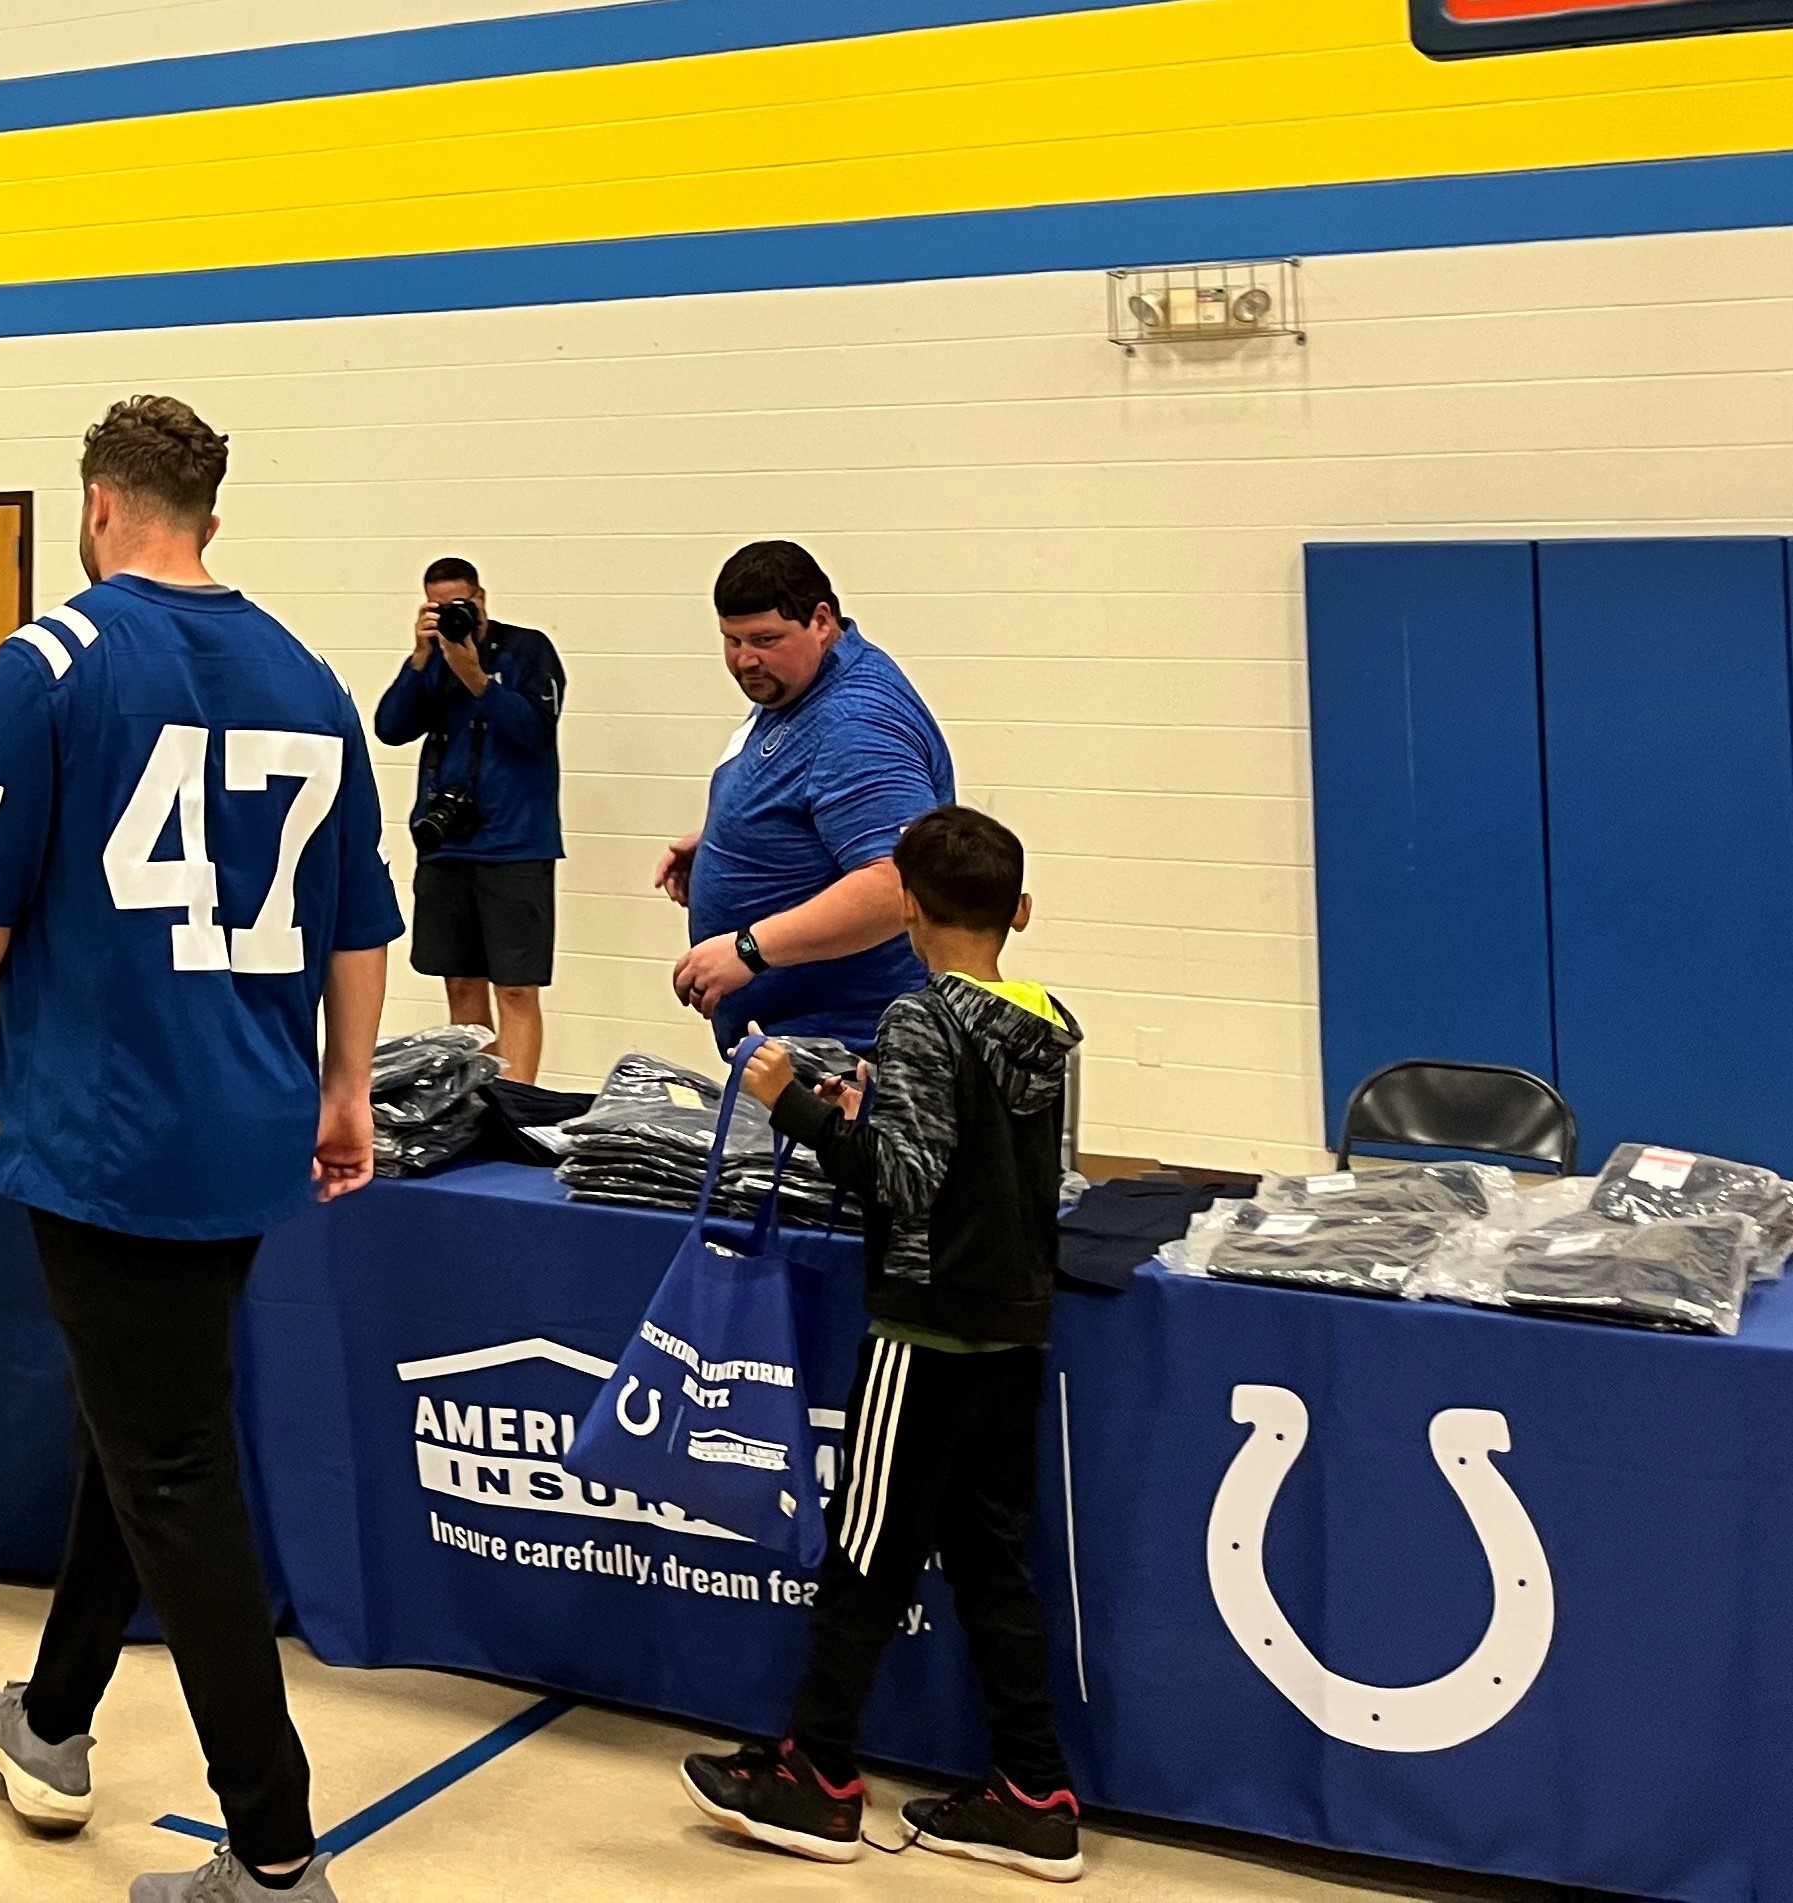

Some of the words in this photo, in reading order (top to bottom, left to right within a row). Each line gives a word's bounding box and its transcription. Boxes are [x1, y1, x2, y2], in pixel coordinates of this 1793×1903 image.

[103, 725, 343, 974] 47
[414, 1396, 576, 1456] AMERI
[430, 1511, 507, 1561] Insure
[514, 1540, 658, 1586] carefully,
[663, 1555, 760, 1601] dream
